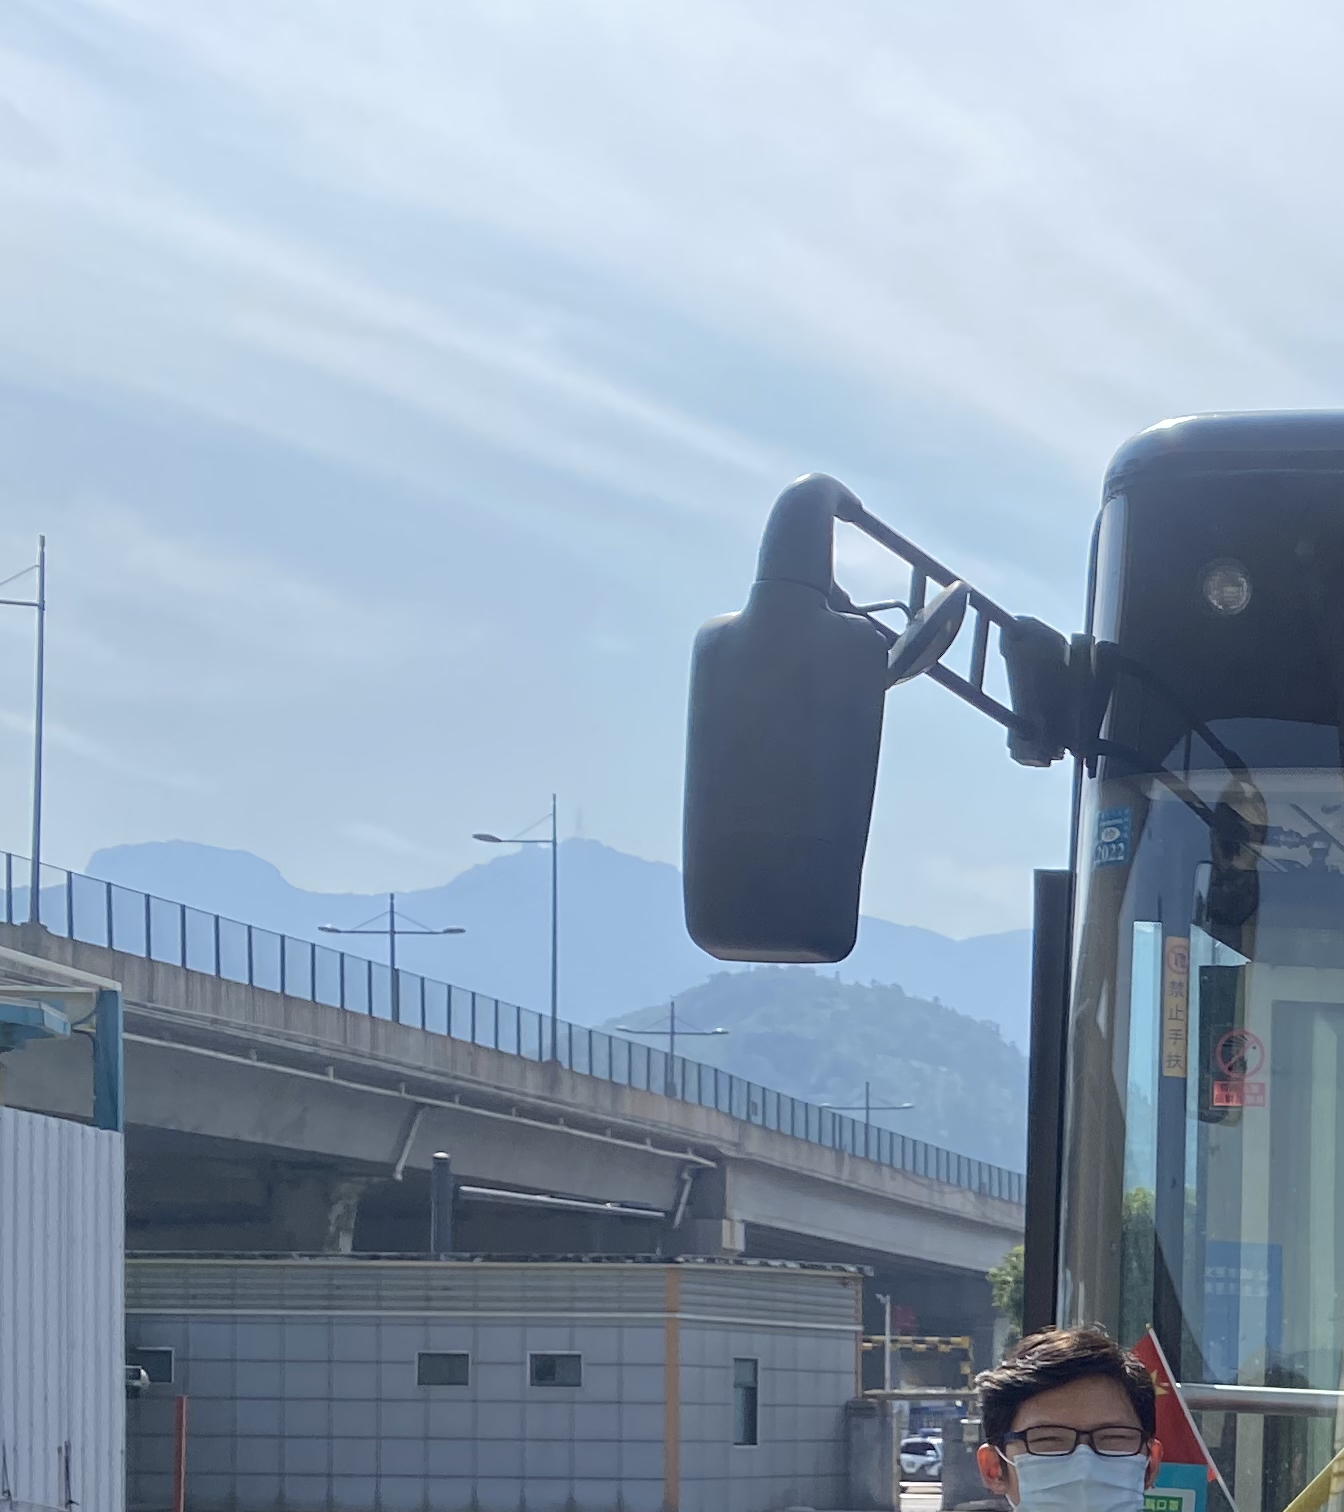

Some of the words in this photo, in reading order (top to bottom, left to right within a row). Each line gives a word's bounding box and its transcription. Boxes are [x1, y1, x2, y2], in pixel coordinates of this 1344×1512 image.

[1094, 842, 1125, 864] 2022
[1165, 979, 1186, 1070] 禁止手扶
